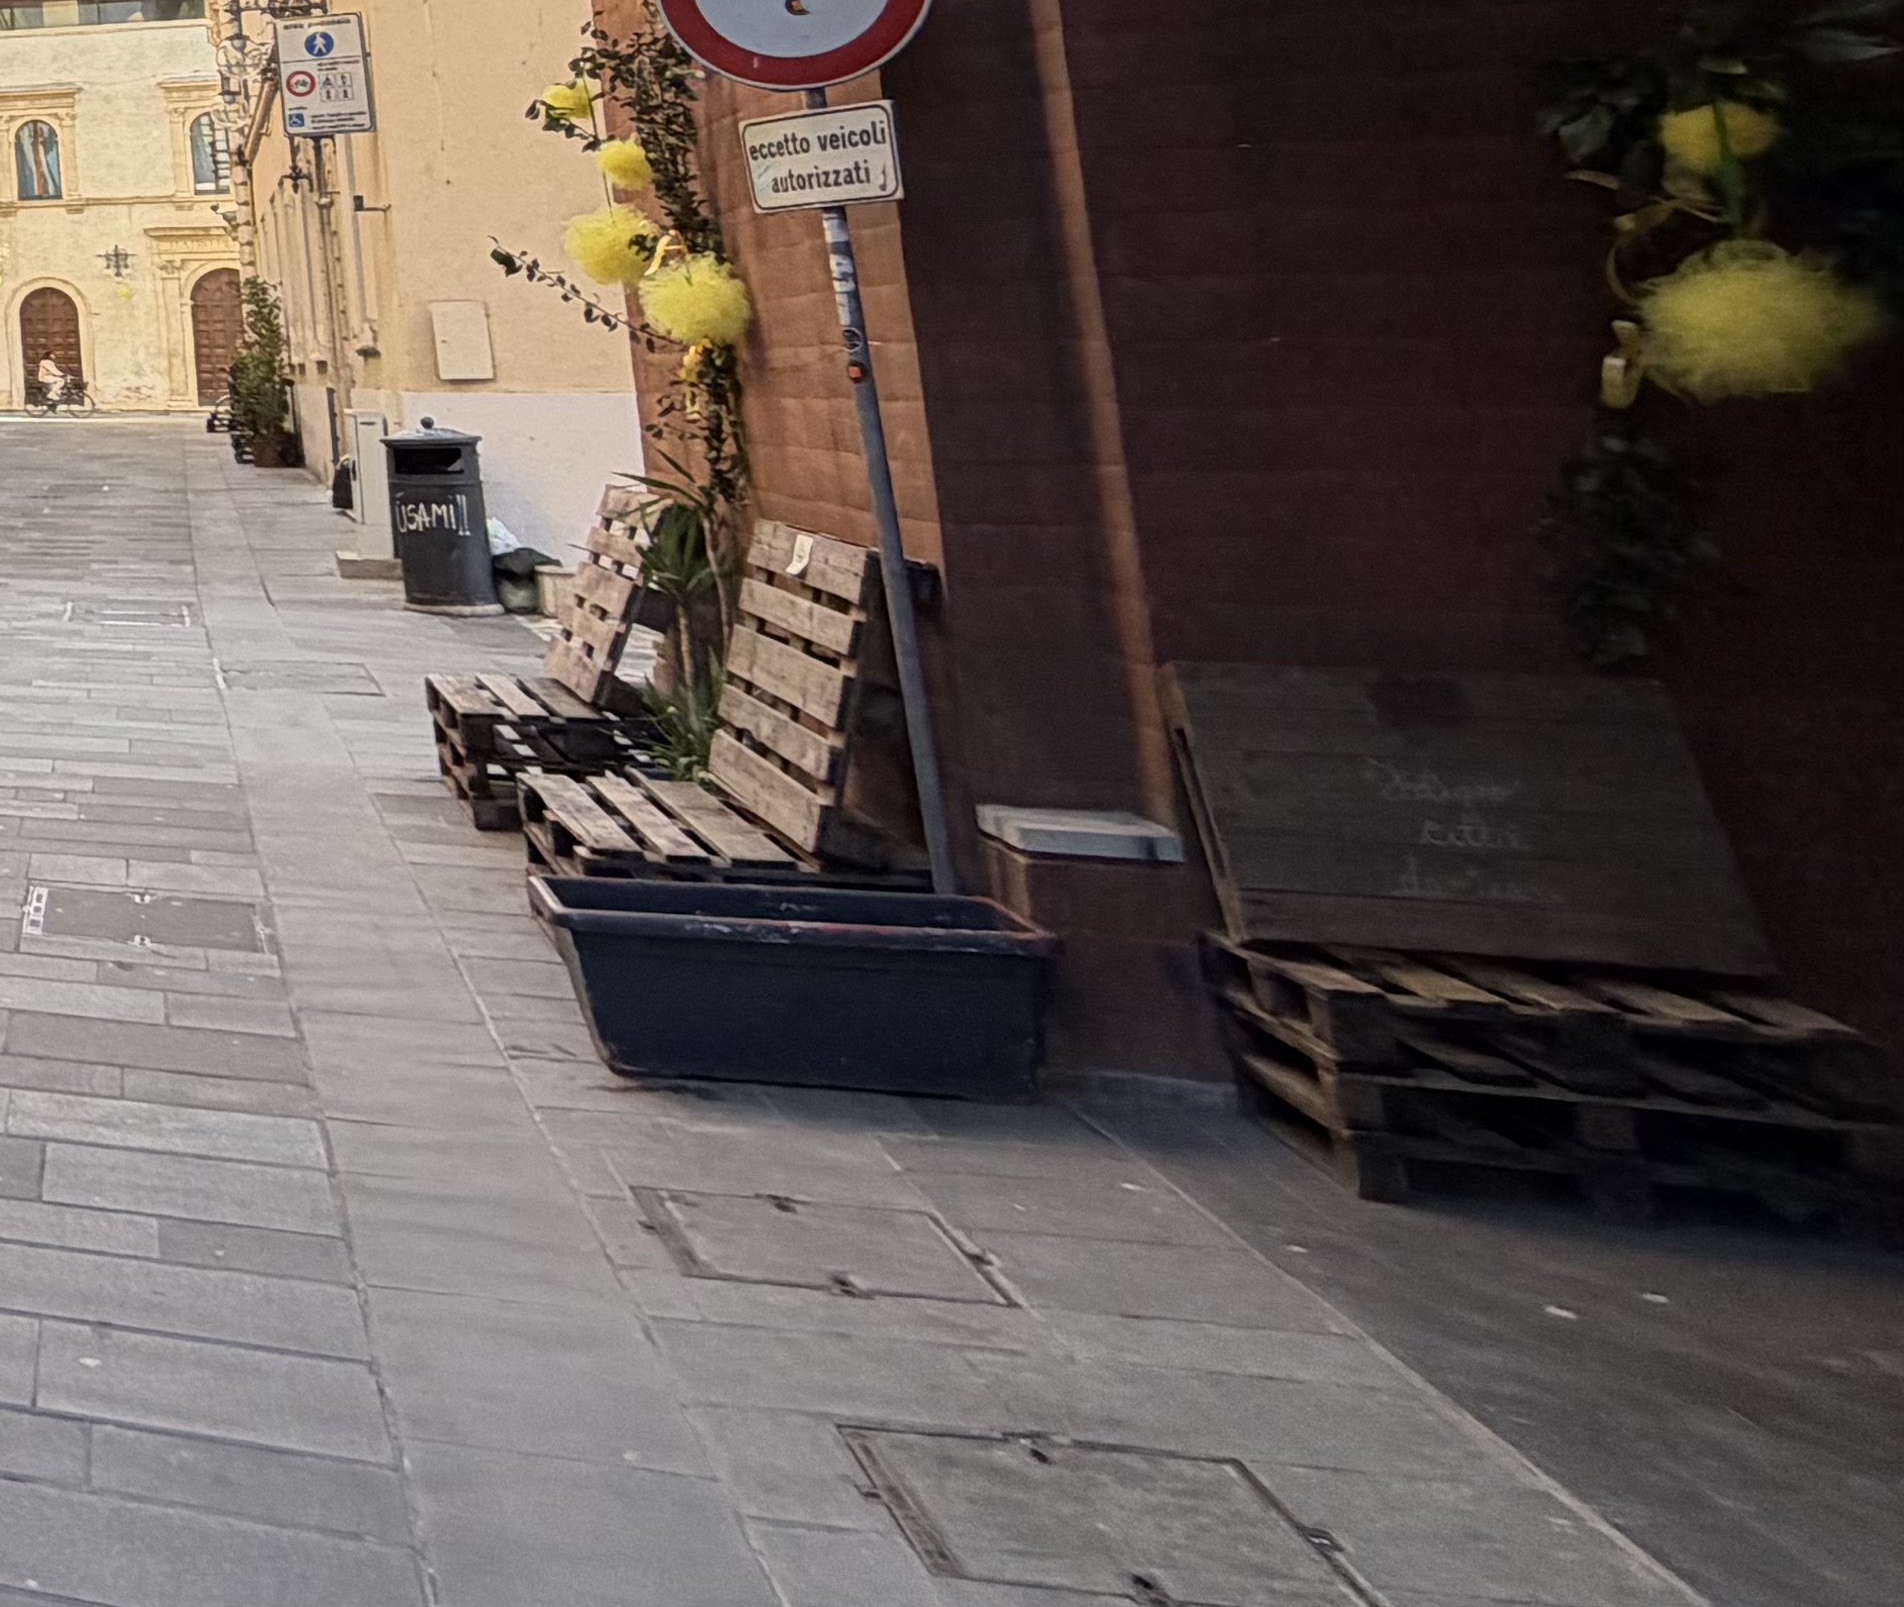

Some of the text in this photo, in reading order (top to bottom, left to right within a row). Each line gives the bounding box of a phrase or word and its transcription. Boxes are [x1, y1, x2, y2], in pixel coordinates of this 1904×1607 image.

[748, 120, 887, 161] eccetto veicoli
[771, 159, 872, 194] autorizzati
